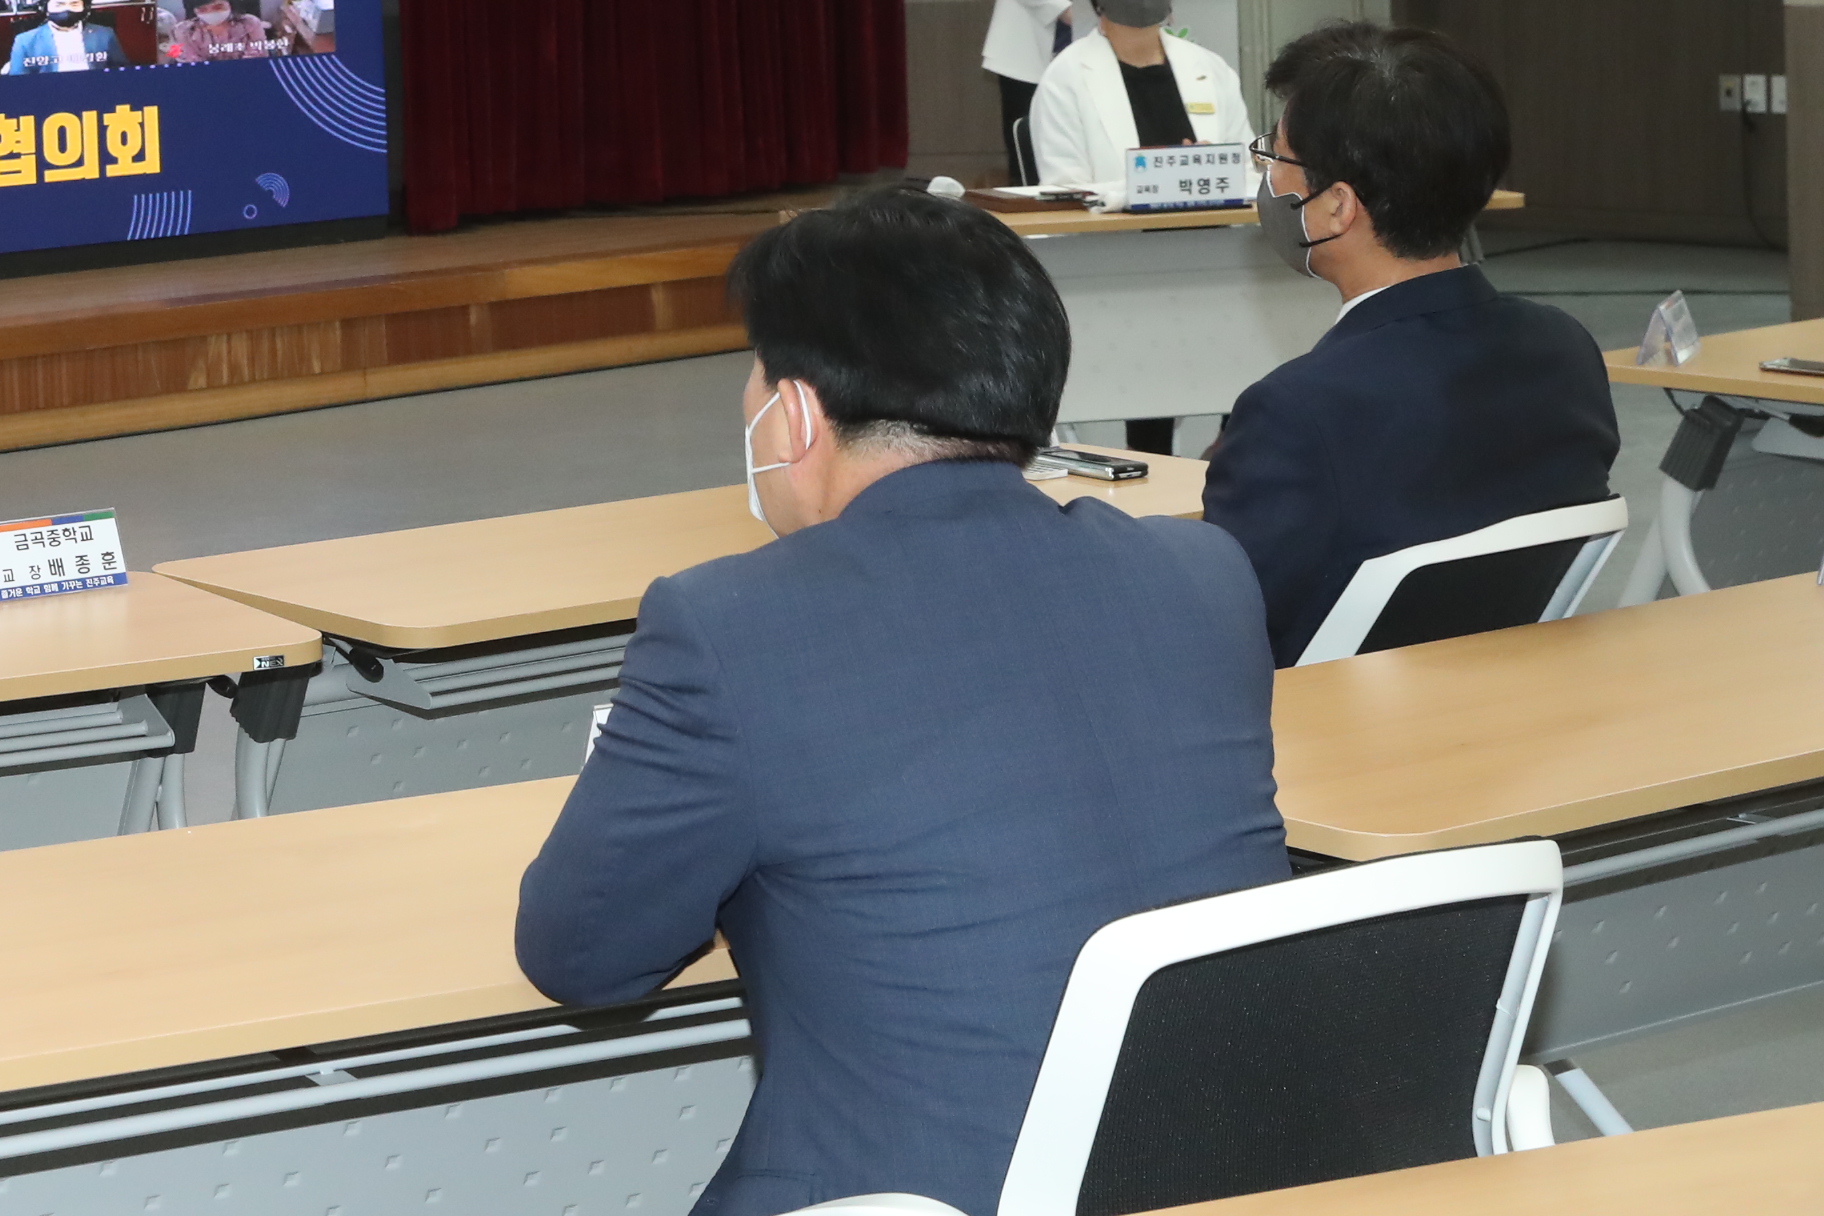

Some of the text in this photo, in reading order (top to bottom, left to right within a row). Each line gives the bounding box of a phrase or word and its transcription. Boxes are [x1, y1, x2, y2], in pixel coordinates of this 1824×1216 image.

[1153, 152, 1241, 168] 진주교육지원청
[1179, 177, 1230, 196] 박영주
[14, 525, 94, 551] 금곡중학교
[1, 588, 24, 599] 즐거운
[26, 585, 41, 596] 학교
[43, 583, 59, 594] 함께
[61, 580, 83, 591] 가꾸는
[85, 575, 114, 588] 진주교육
